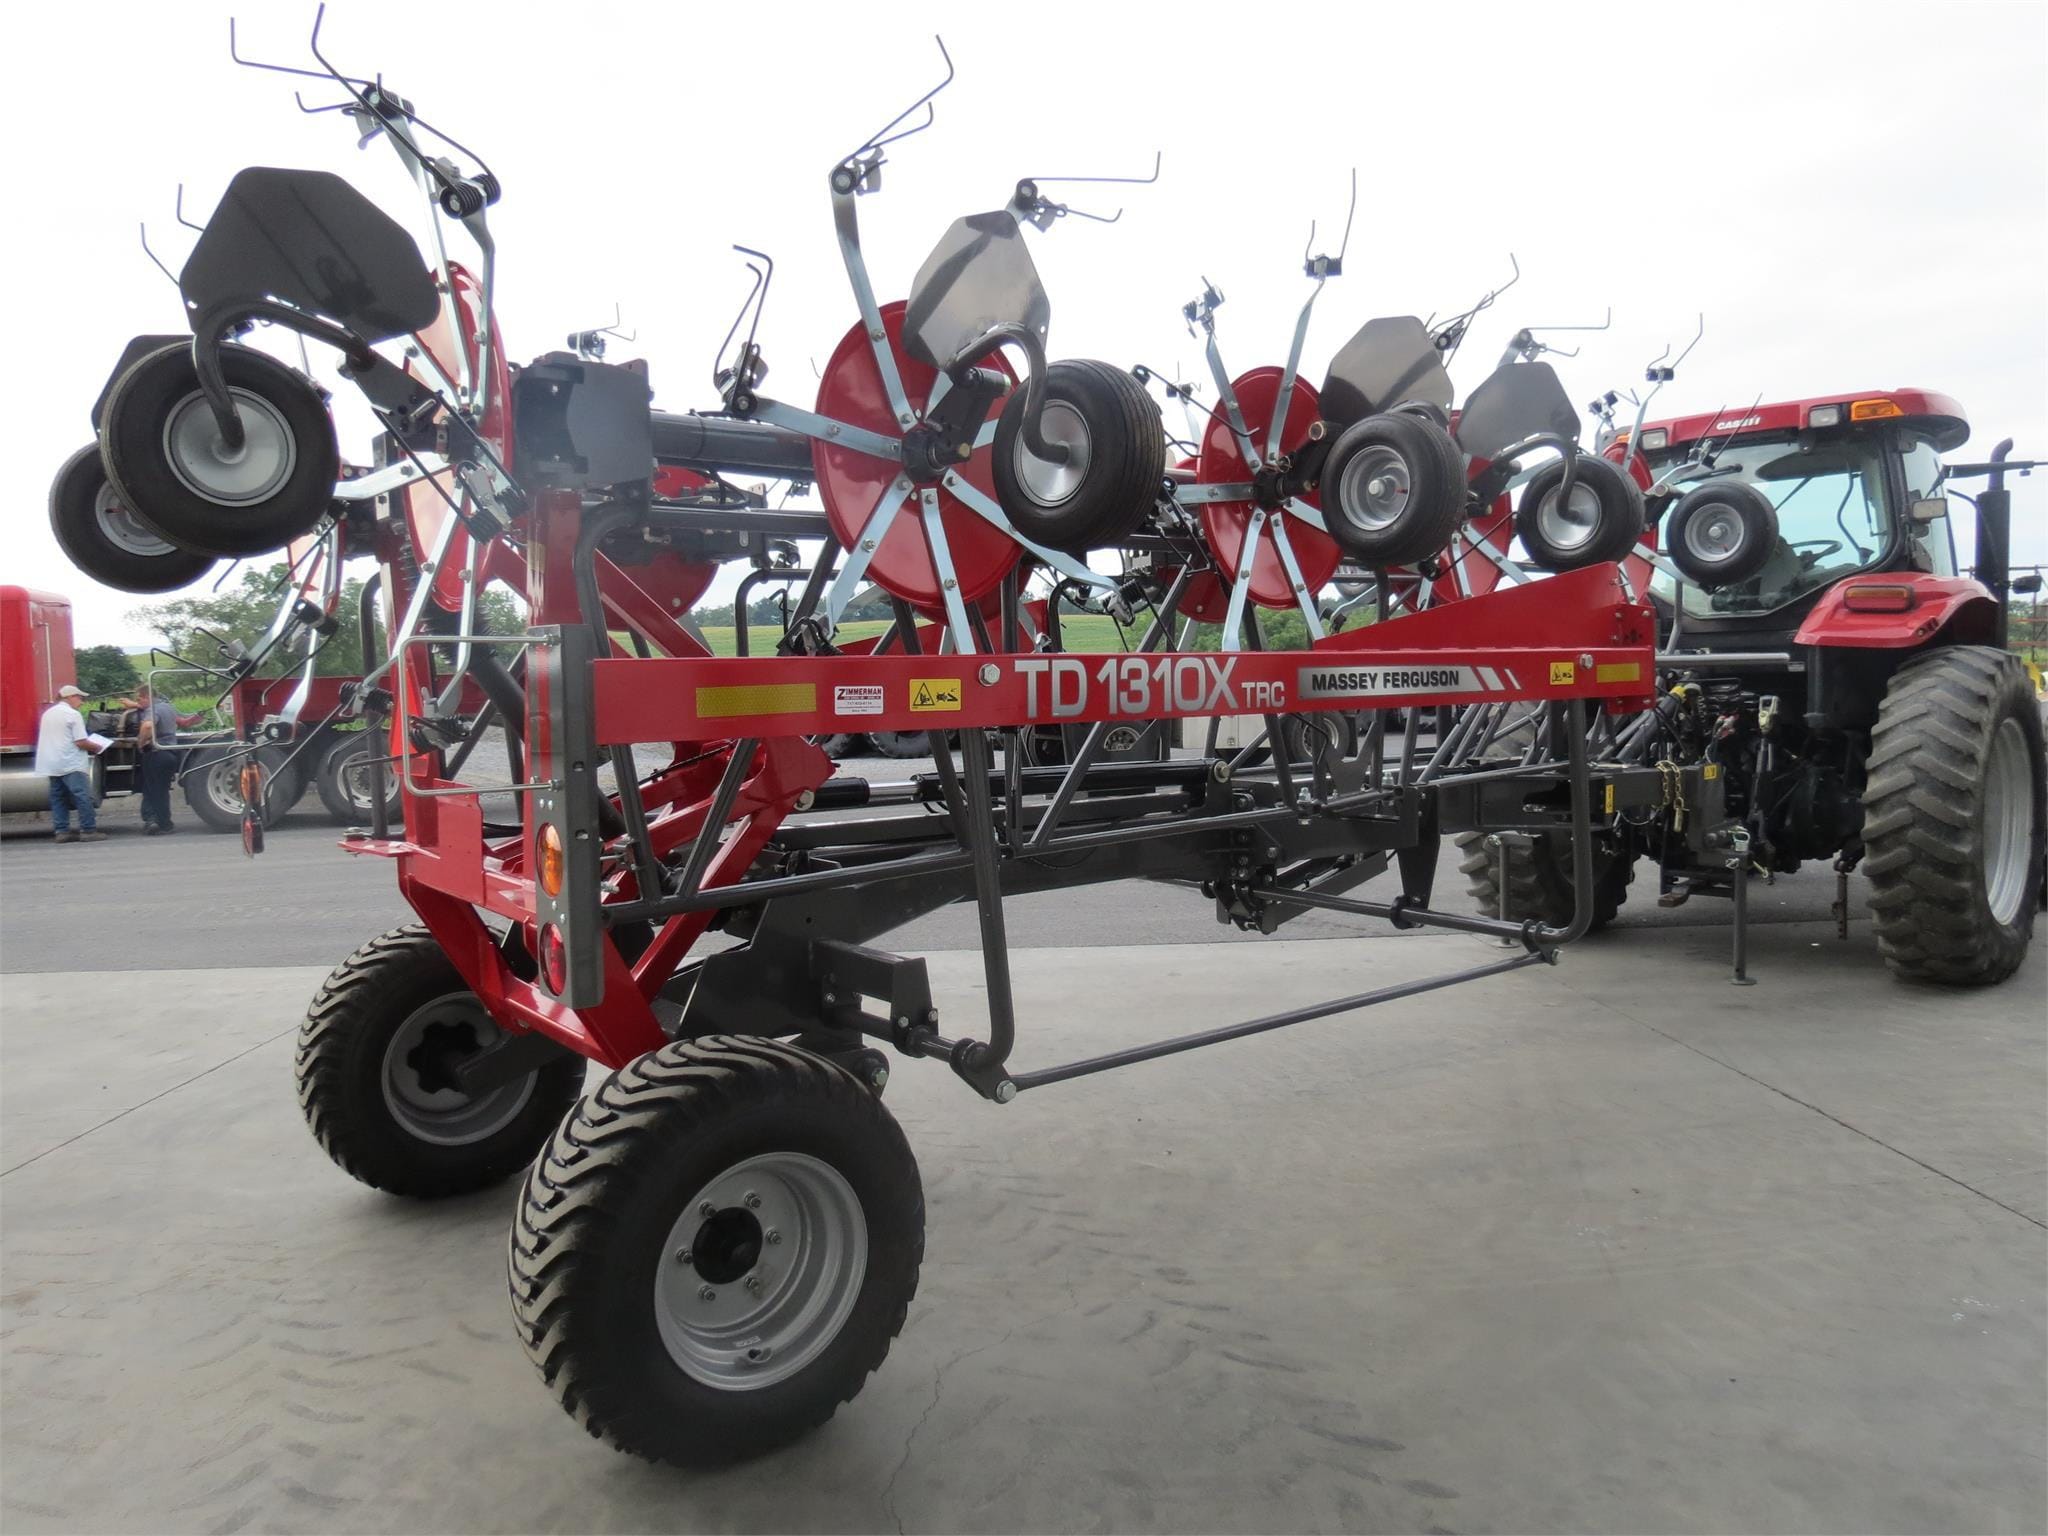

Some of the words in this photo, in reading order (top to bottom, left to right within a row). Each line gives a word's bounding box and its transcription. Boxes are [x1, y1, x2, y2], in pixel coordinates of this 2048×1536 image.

[1015, 660, 1087, 718] TD
[1097, 656, 1239, 715] 1310X
[1241, 681, 1286, 709] TRC
[1312, 672, 1378, 691] MASSEY
[1383, 670, 1459, 689] FERGUSON
[837, 688, 881, 700] ZIMMERMAN
